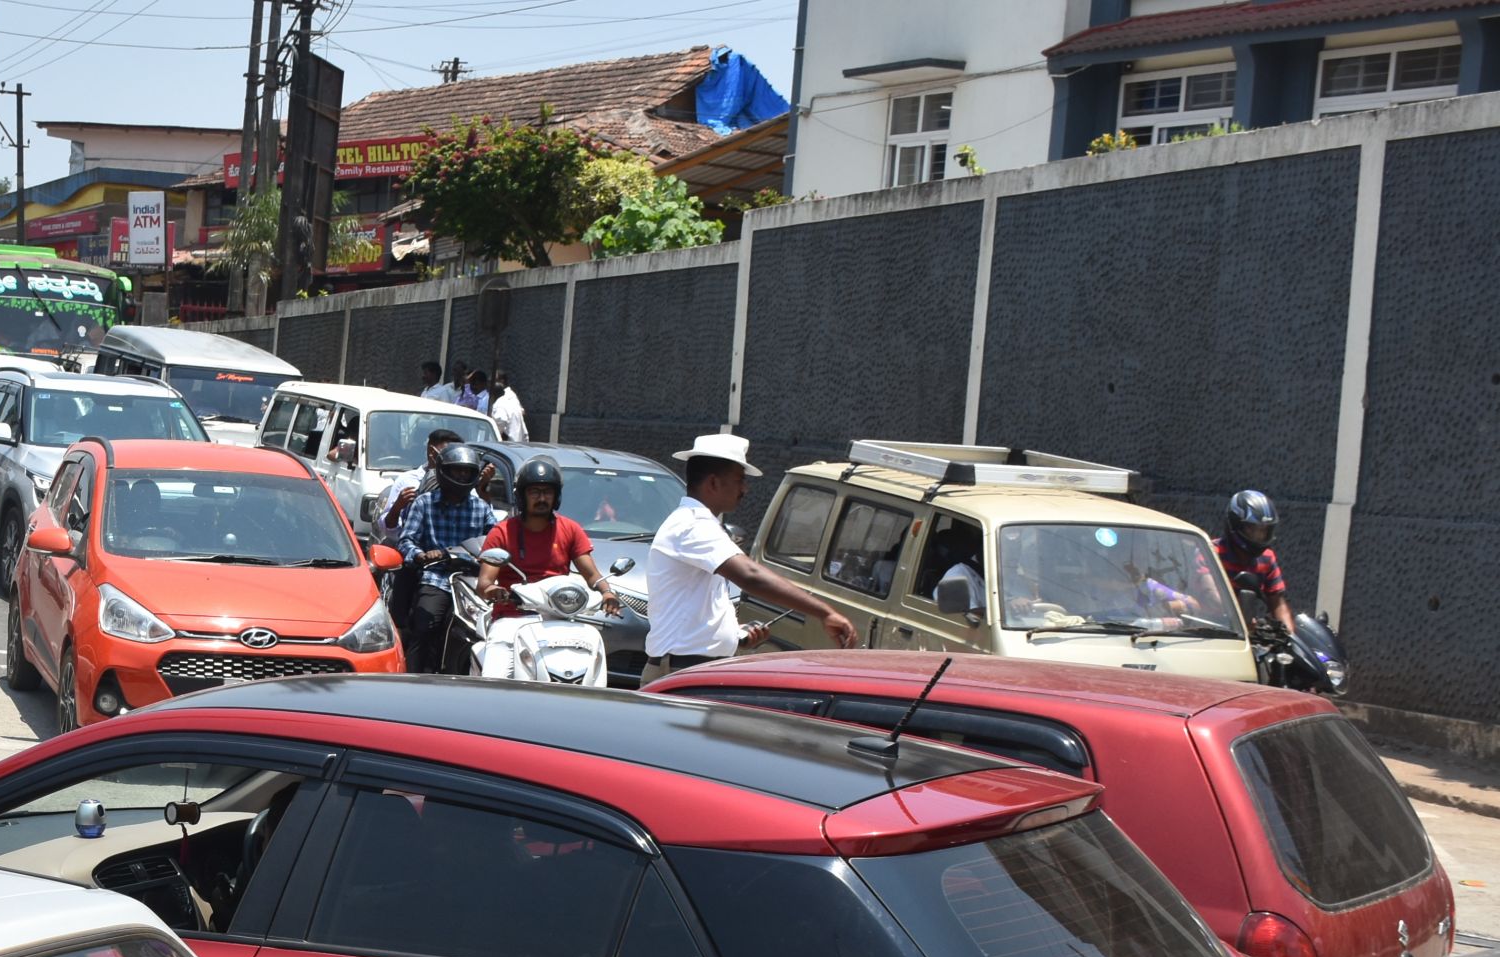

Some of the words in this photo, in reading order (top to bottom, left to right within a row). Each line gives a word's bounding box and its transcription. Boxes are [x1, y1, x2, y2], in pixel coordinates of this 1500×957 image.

[337, 146, 364, 165] TEL
[334, 166, 363, 177] Family
[133, 216, 161, 229] ATM
